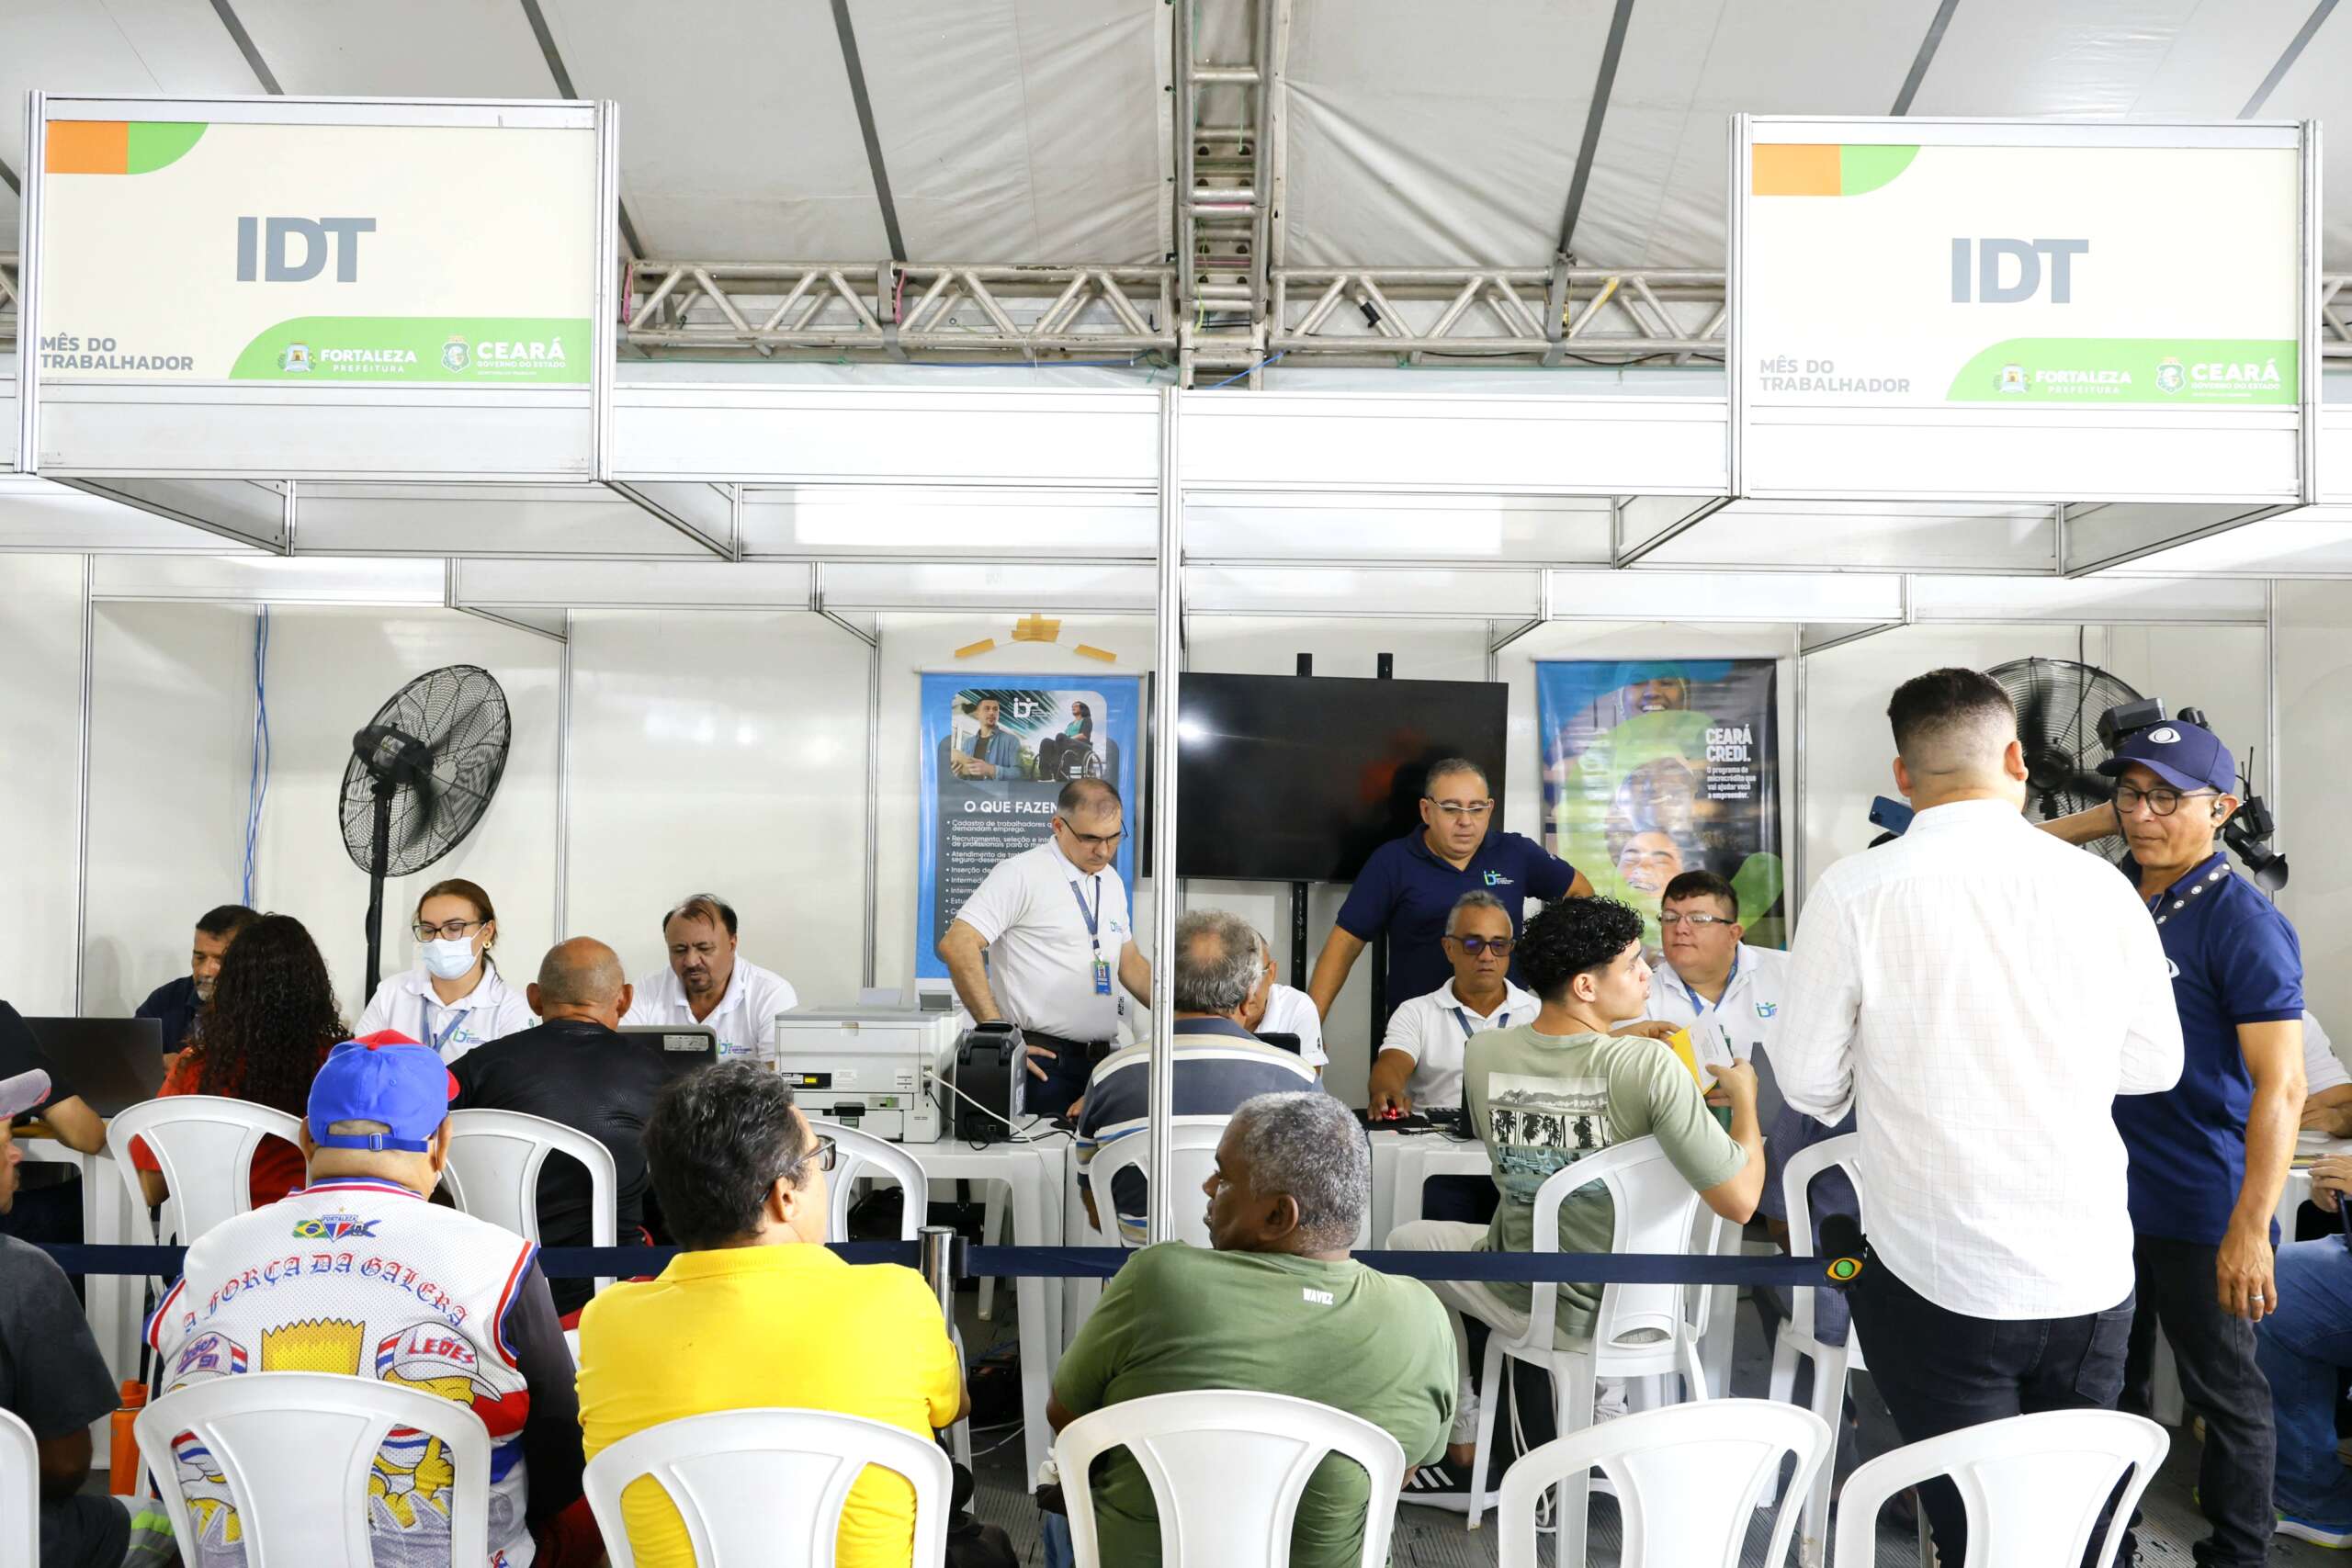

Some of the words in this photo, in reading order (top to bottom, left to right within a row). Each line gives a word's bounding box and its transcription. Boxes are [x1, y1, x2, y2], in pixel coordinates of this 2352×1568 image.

[236, 217, 377, 283] IDT
[1951, 238, 2089, 303] IDT
[40, 332, 80, 351] MÊS
[87, 337, 116, 352] DO
[477, 336, 566, 359] CEARÁ
[40, 354, 194, 370] TRABALHADOR
[321, 349, 417, 362] FORTALEZA
[1759, 355, 1798, 374] MÊS
[1806, 359, 1835, 374] DO
[2190, 357, 2280, 381] CEARÁ
[2035, 369, 2132, 383] FORTALEZA
[1759, 377, 1910, 392] TRABALHADOR
[2048, 385, 2120, 394] PREFEITURA
[1705, 723, 1753, 745] CEARÁ
[1713, 766, 1740, 775] programa
[964, 800, 976, 813] O
[980, 800, 1011, 813] QUE
[1003, 835, 1031, 844] seleção
[951, 866, 980, 874] Inserção
[204, 1256, 301, 1320] FORÇA
[310, 1252, 354, 1274] DA
[359, 1257, 468, 1327] GALERA
